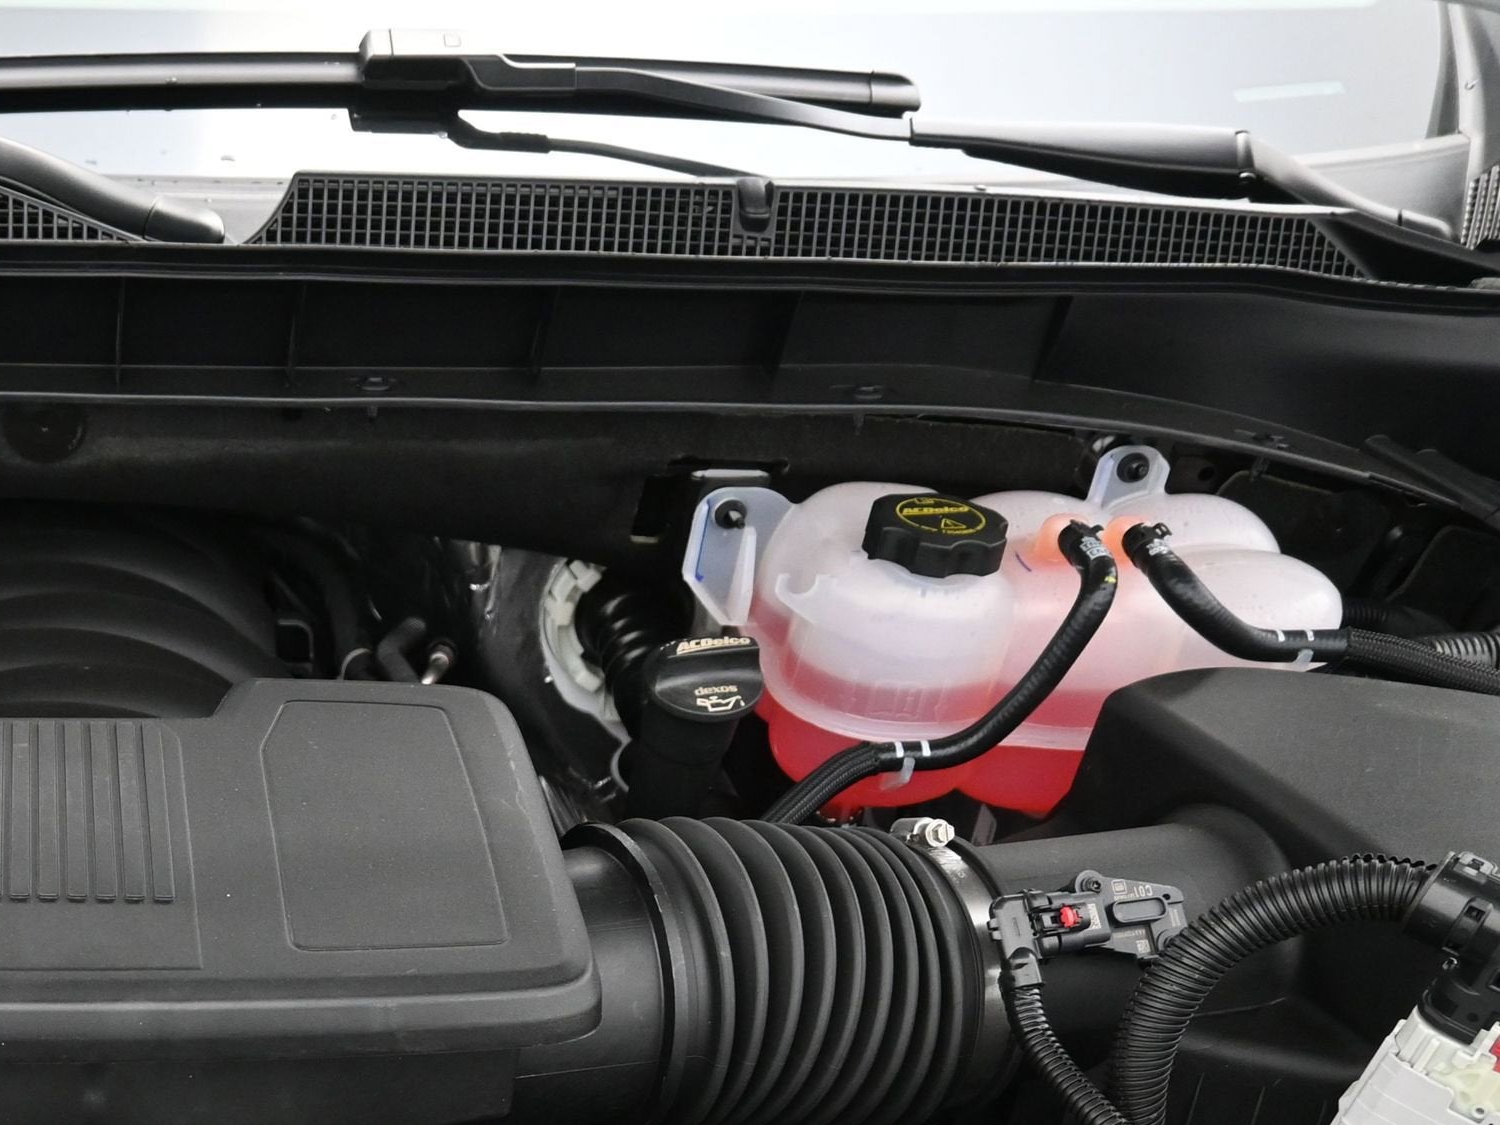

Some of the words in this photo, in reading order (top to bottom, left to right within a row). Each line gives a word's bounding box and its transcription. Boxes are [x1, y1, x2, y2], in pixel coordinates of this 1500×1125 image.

[902, 506, 970, 516] ACDelco
[676, 636, 751, 655] ACDelco
[694, 685, 738, 696] dexos
[1133, 884, 1153, 897] C01
